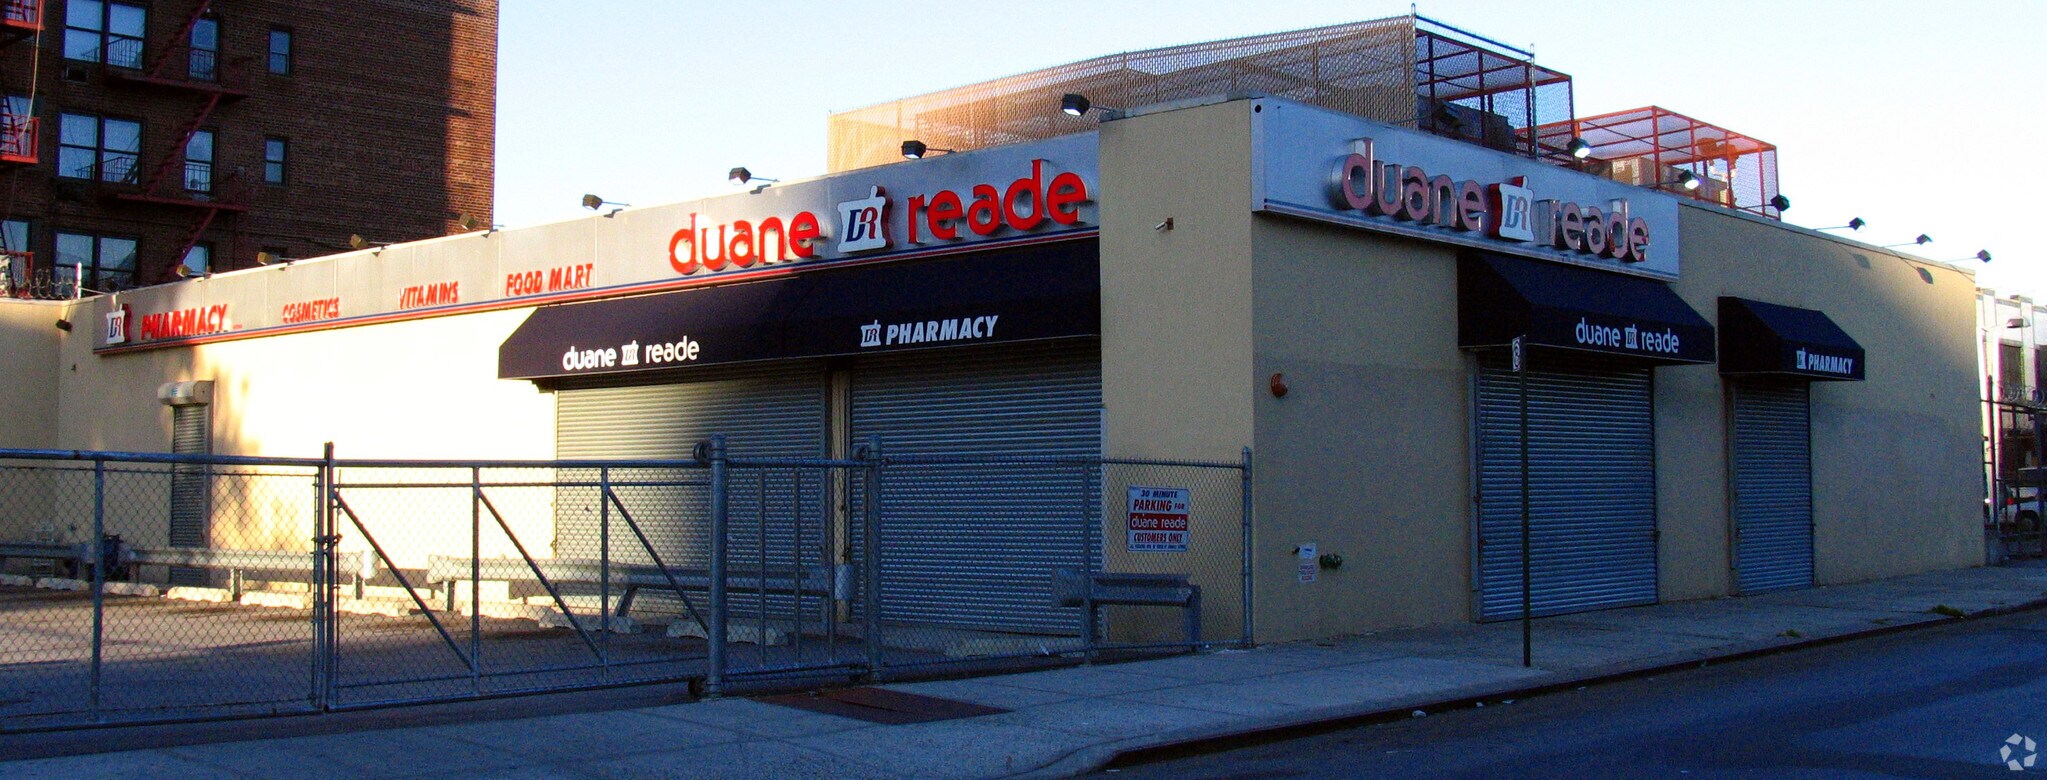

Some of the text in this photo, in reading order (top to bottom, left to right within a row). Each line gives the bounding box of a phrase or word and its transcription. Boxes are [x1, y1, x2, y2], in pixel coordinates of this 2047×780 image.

[1338, 137, 1487, 231] duane
[1542, 198, 1650, 262] reade
[669, 212, 822, 275] duane
[908, 158, 1088, 244] reade
[505, 263, 594, 297] FOOD MART
[400, 281, 459, 309] VITAMINS
[140, 303, 229, 340] PHARMACY
[282, 297, 340, 323] COSMETICS
[885, 315, 999, 346] PHARMACY
[1575, 317, 1621, 347] duane
[1641, 327, 1680, 354] reade
[562, 345, 617, 371] duane
[645, 335, 700, 364] reade
[1808, 353, 1853, 374] PHARMACY
[1133, 499, 1173, 512] PARKING
[1141, 489, 1178, 499] 30 MINUTE
[1131, 515, 1186, 529] duane reade
[1133, 532, 1183, 543] CUSTOMERS ONLY
